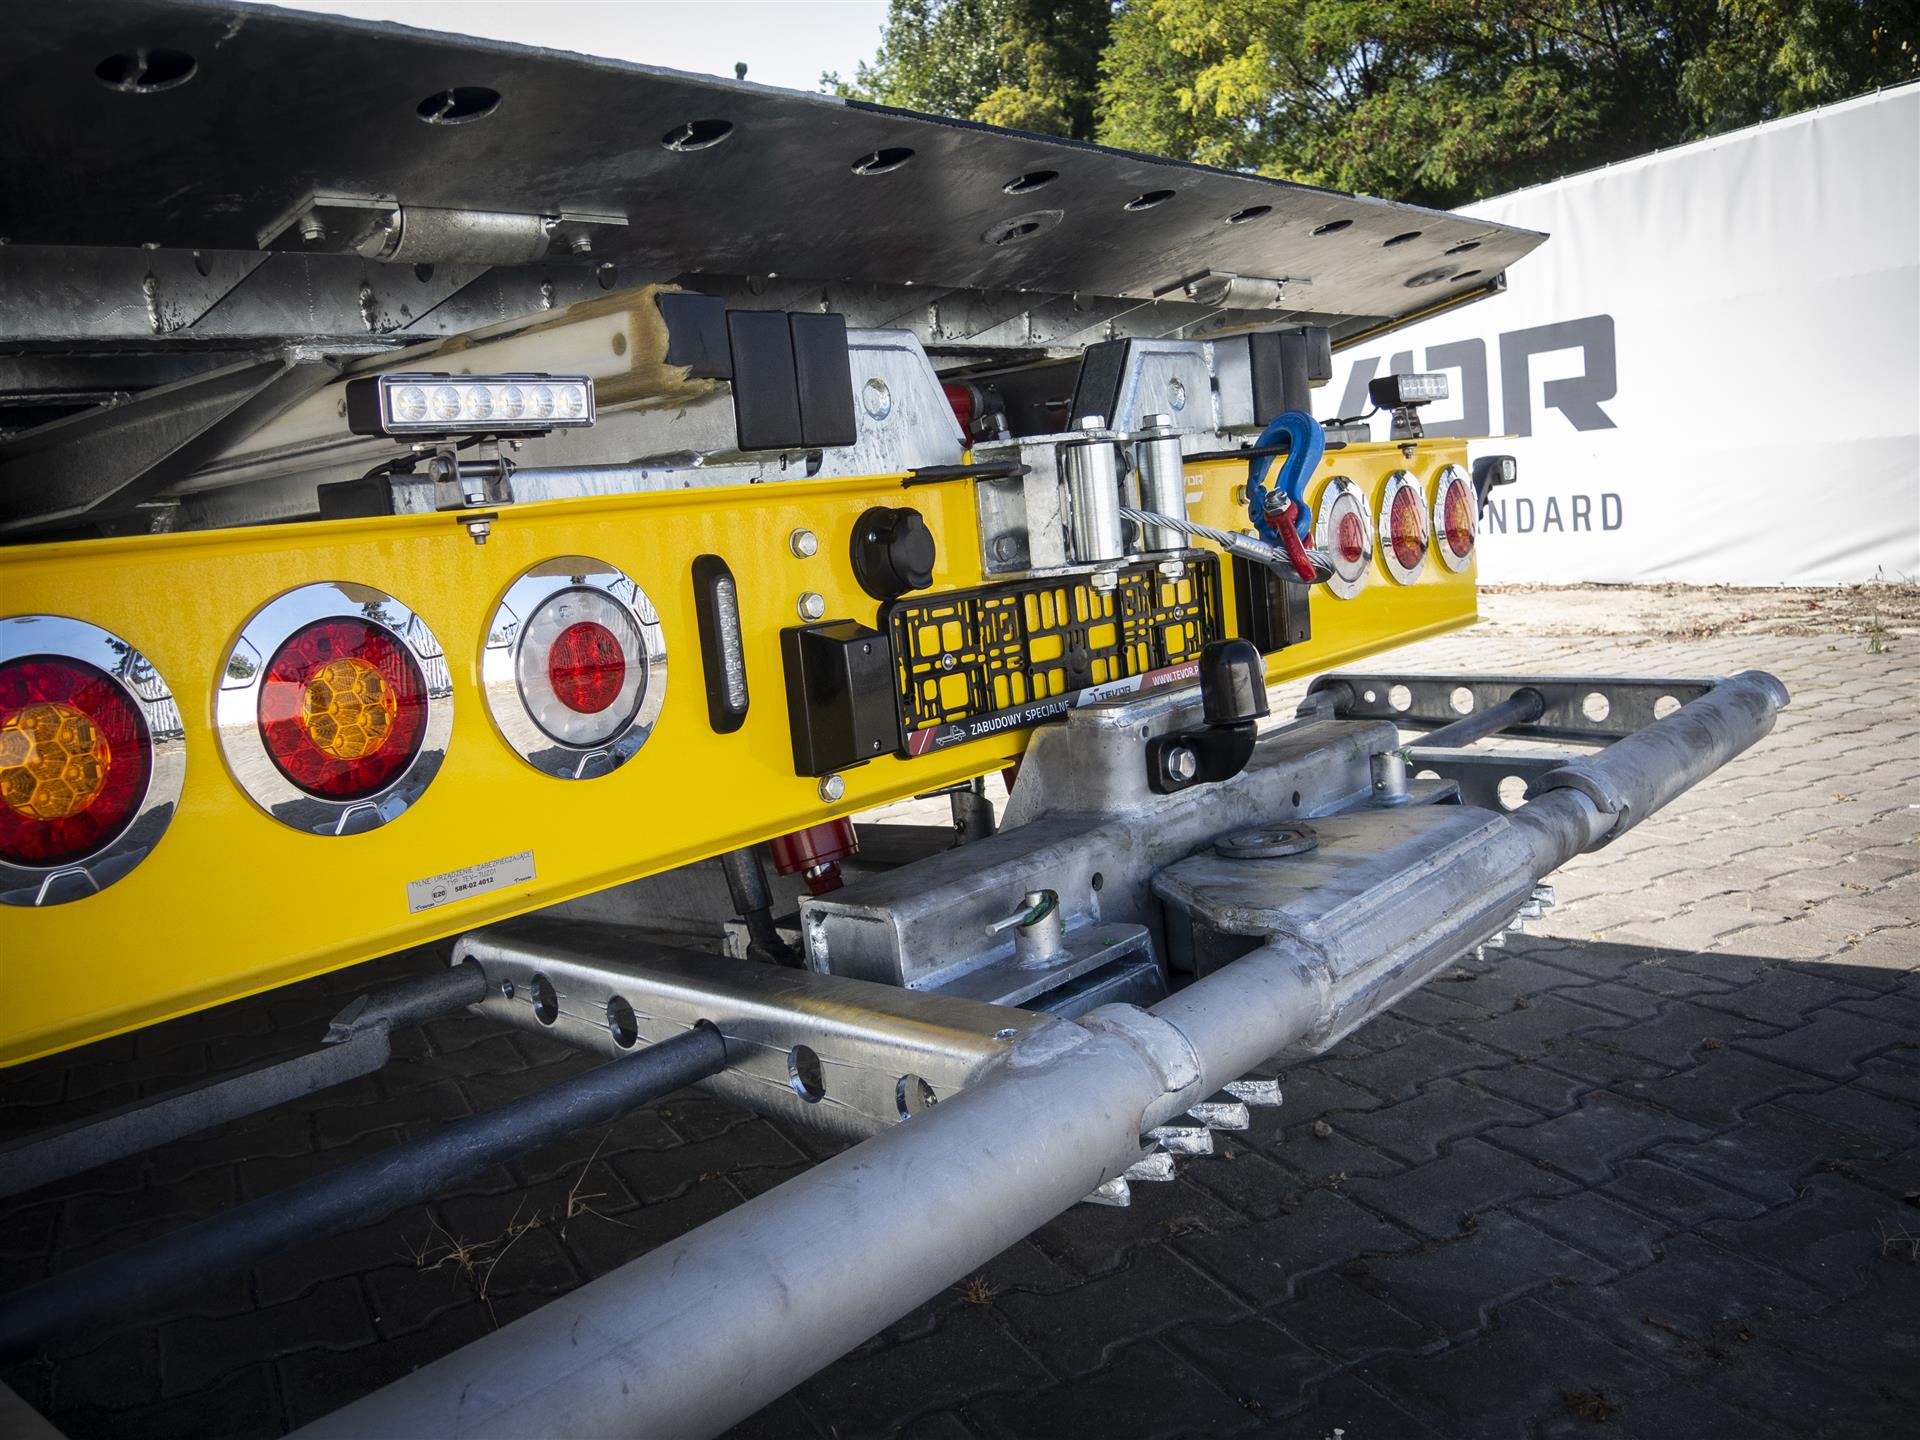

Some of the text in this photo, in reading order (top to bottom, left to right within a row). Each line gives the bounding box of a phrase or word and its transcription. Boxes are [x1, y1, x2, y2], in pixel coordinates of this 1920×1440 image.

[1479, 492, 1622, 534] NDARD
[970, 665, 1200, 735] ZABUDOWY SPECJALNE TEVOR WWW.TEVOR.P
[411, 852, 531, 888] TYLNE URZĄDZENIE ZABEZPIECZAJĄCE
[433, 877, 494, 898] E20 58R-02 4012
